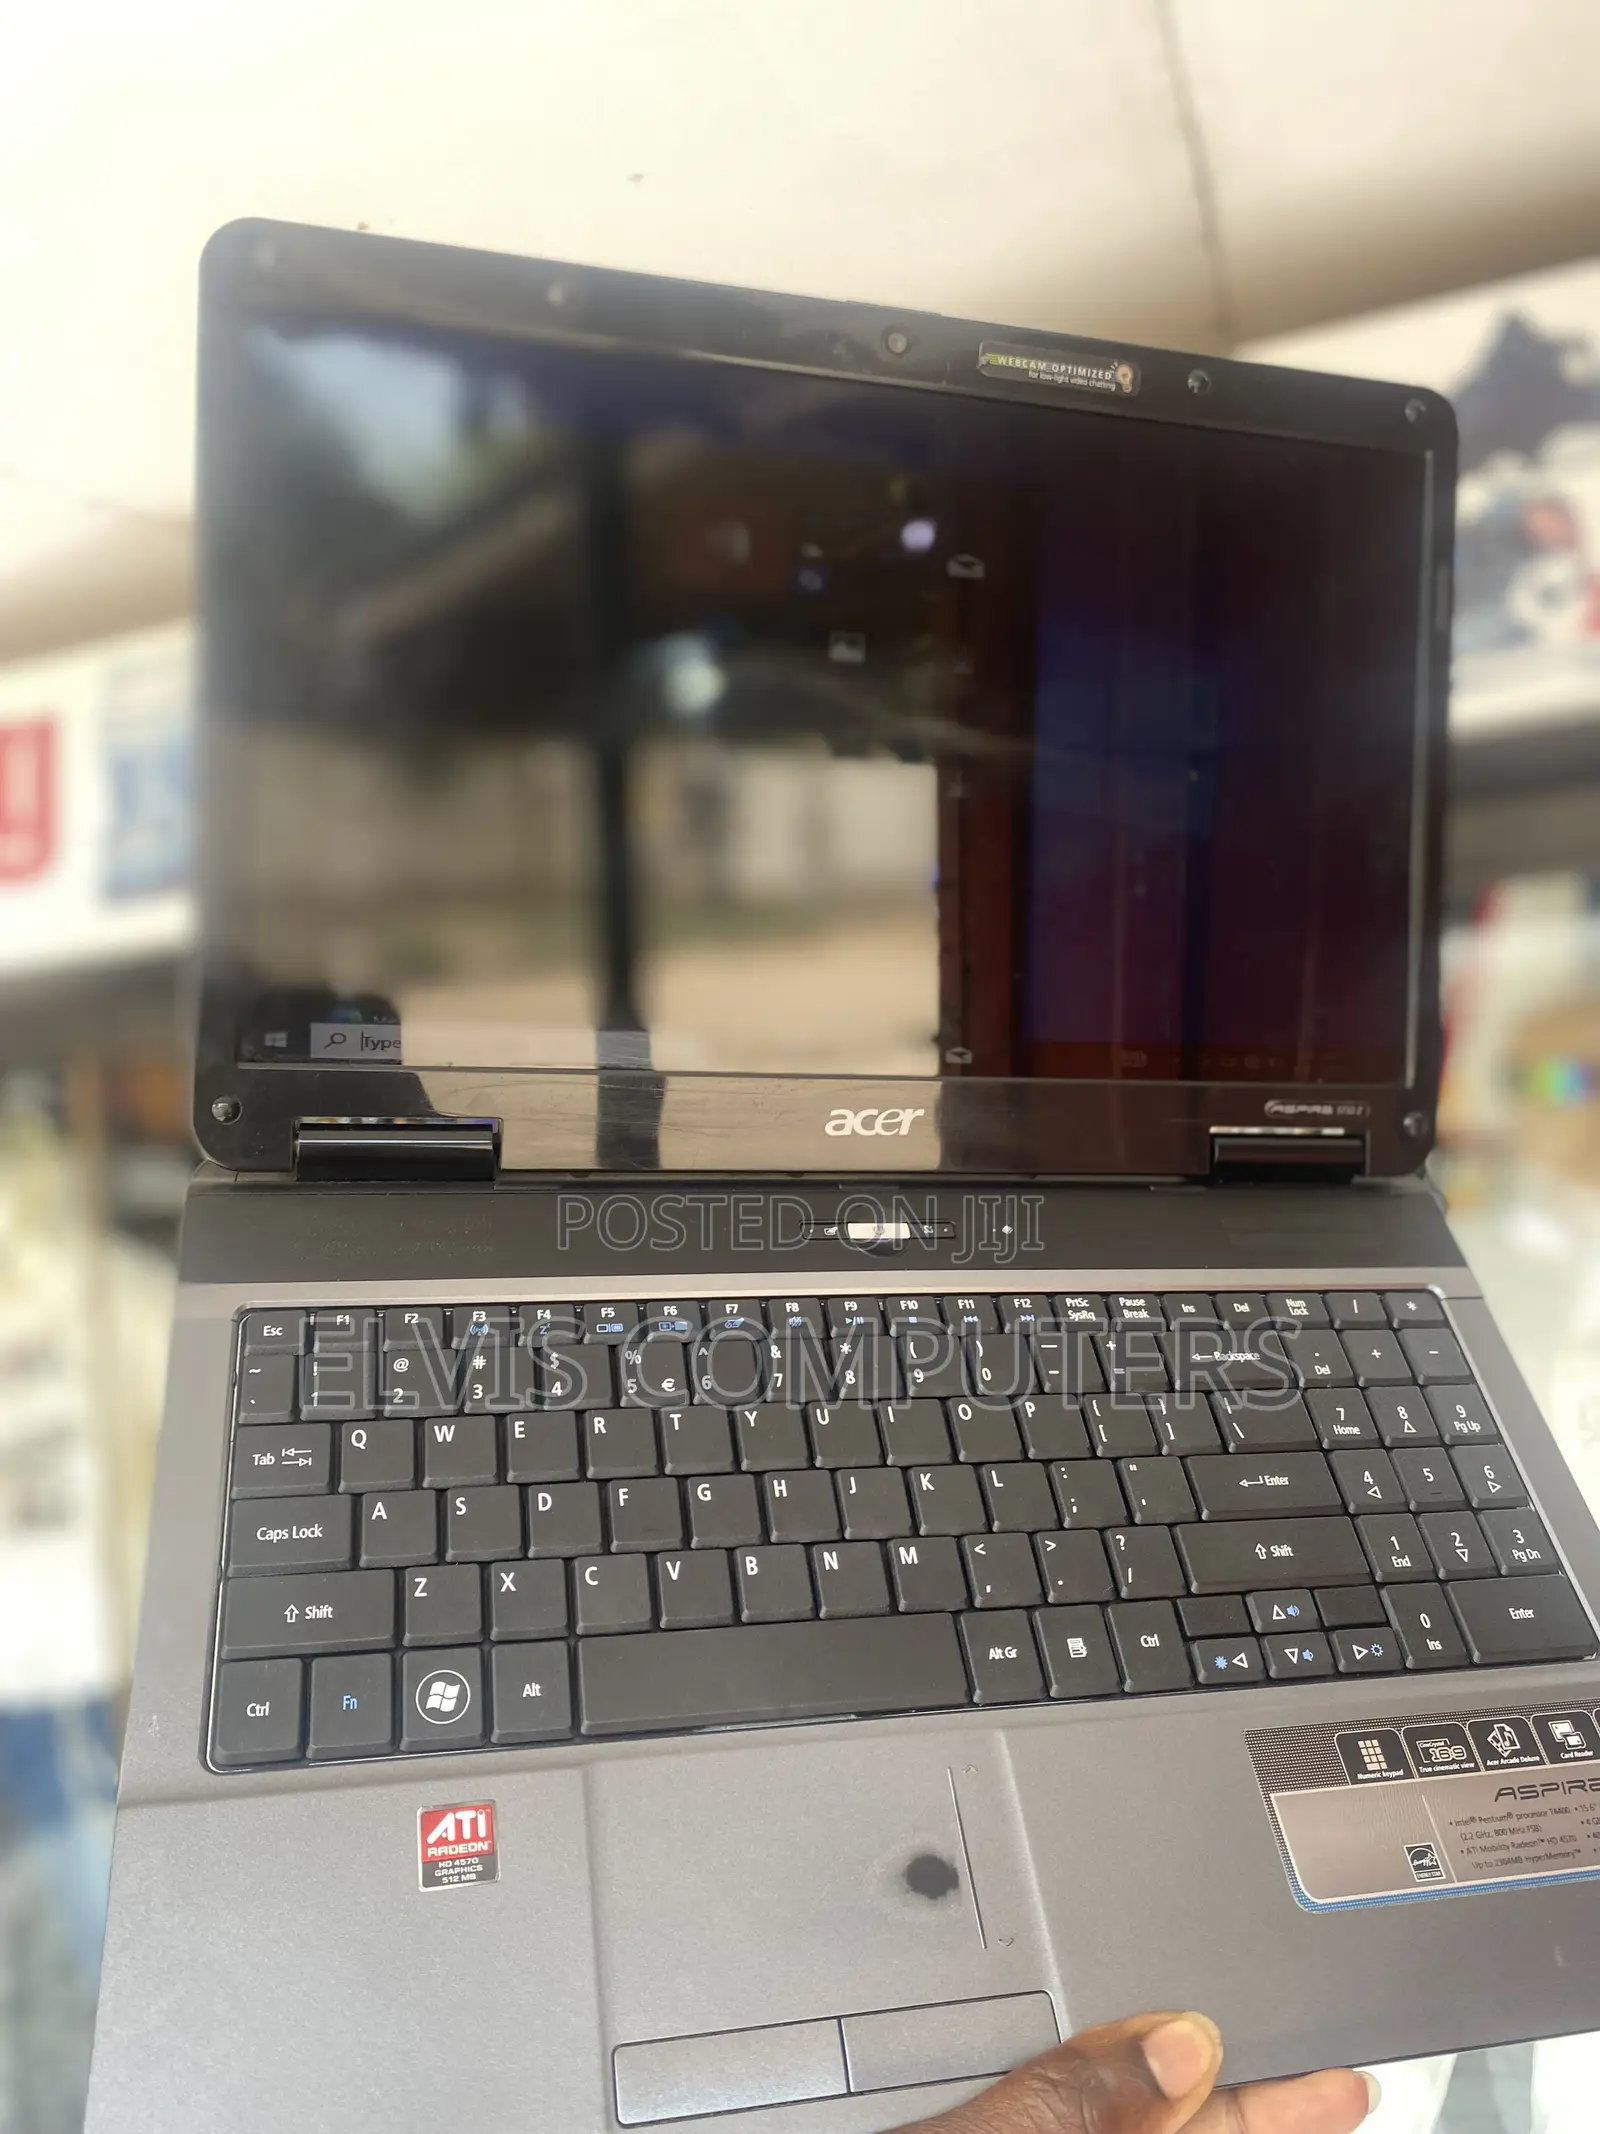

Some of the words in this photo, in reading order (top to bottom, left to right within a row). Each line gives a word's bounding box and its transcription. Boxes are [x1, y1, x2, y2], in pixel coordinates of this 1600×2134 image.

[998, 355, 1046, 370] WEBCAM
[1052, 364, 1112, 380] OPTIMIZED
[1029, 370, 1037, 378] for
[1040, 373, 1068, 384] low-light
[1070, 376, 1087, 386] video
[1089, 379, 1116, 391] chatting
[363, 1036, 400, 1051] Type
[824, 1108, 925, 1136] acer
[726, 1304, 738, 1313] F7
[786, 1302, 799, 1312] F8
[844, 1301, 857, 1311] F9
[900, 1300, 918, 1310] F10
[958, 1299, 974, 1309] F11
[1014, 1299, 1032, 1308] F12
[1066, 1298, 1089, 1307] PrtSc
[1119, 1297, 1146, 1306] Pause
[1182, 1304, 1195, 1312] Ins
[1234, 1303, 1250, 1312] Del
[1286, 1298, 1307, 1308] Num
[405, 1313, 419, 1323] F2
[473, 1311, 486, 1321] F3
[537, 1310, 551, 1319] F4
[601, 1308, 615, 1317] F5
[664, 1306, 677, 1315] F6
[1068, 1310, 1096, 1321] SysRq
[1123, 1309, 1150, 1318] Break
[1289, 1306, 1309, 1316] Lock
[337, 1315, 349, 1325] F1
[264, 1326, 282, 1336] Esc
[625, 1350, 641, 1364] %
[770, 1345, 781, 1358] &
[1213, 1350, 1261, 1363] Backspace
[393, 1357, 410, 1373] @
[471, 1354, 487, 1370] #
[550, 1352, 559, 1369] $
[844, 1369, 856, 1385] 8
[913, 1368, 925, 1383] 9
[981, 1367, 992, 1382] 0
[1315, 1365, 1331, 1374] Del
[627, 1379, 638, 1394] 5
[661, 1377, 676, 1393] €
[702, 1375, 712, 1390] 6
[773, 1372, 784, 1388] 7
[393, 1387, 404, 1403] 2
[472, 1383, 483, 1400] 3
[551, 1381, 563, 1397] 4
[311, 1392, 319, 1407] 1
[815, 1407, 830, 1426] U
[887, 1405, 895, 1423] I
[957, 1403, 973, 1421] O
[1024, 1401, 1036, 1418] P
[1335, 1407, 1345, 1421] 7
[1396, 1405, 1409, 1420] 8
[1455, 1404, 1467, 1418] 9
[593, 1416, 607, 1434] R
[669, 1413, 682, 1431] T
[744, 1410, 758, 1428] Y
[433, 1424, 456, 1443] W
[514, 1420, 526, 1439] E
[1333, 1425, 1360, 1434] Home
[1454, 1421, 1470, 1433] Pg
[1467, 1421, 1480, 1432] Up
[350, 1429, 367, 1450] Q
[253, 1453, 275, 1465] Tab
[991, 1469, 1004, 1488] L
[1363, 1470, 1374, 1485] 4
[1422, 1467, 1434, 1482] 5
[1483, 1465, 1495, 1480] 6
[849, 1476, 857, 1495] J
[919, 1472, 935, 1491] K
[1264, 1476, 1289, 1485] Enter
[696, 1483, 712, 1502] G
[772, 1479, 788, 1498] H
[537, 1492, 553, 1512] D
[618, 1487, 629, 1507] F
[371, 1501, 388, 1520] A
[455, 1496, 467, 1516] S
[257, 1527, 288, 1543] Caps
[293, 1524, 322, 1538] Lock
[1450, 1531, 1464, 1547] 2
[1512, 1529, 1525, 1544] 3
[1115, 1534, 1126, 1551] ?
[1390, 1535, 1400, 1551] 1
[898, 1546, 919, 1565] M
[1270, 1545, 1293, 1557] Shift
[1512, 1550, 1527, 1562] Pg
[1526, 1549, 1541, 1559] Dn
[745, 1555, 759, 1576] B
[822, 1551, 839, 1571] N
[1392, 1555, 1411, 1567] End
[584, 1566, 599, 1586] C
[665, 1560, 681, 1581] V
[413, 1577, 428, 1598] Z
[500, 1571, 517, 1593] X
[305, 1605, 333, 1619] Shift
[1509, 1608, 1534, 1619] Enter
[1419, 1613, 1431, 1629] 0
[1141, 1634, 1159, 1647] Ctrl
[1427, 1639, 1442, 1650] Ins
[989, 1647, 1004, 1659] Alt
[1005, 1647, 1017, 1658] Gr
[523, 1683, 541, 1697] Alt
[247, 1702, 269, 1717] Ctrl
[343, 1695, 357, 1710] Fn
[1520, 1755, 1540, 1763] Deluxe
[1357, 1771, 1381, 1780] Numeric
[1382, 1769, 1404, 1778] keypad
[1434, 1764, 1460, 1772] cinematic
[1516, 1812, 1548, 1821] processor
[427, 1809, 487, 1844] ATI
[439, 1860, 452, 1868] HD
[454, 1857, 479, 1866] 4570
[435, 1865, 483, 1877] GRAPHICS
[442, 1875, 459, 1883] 512
[461, 1873, 476, 1881] MB
